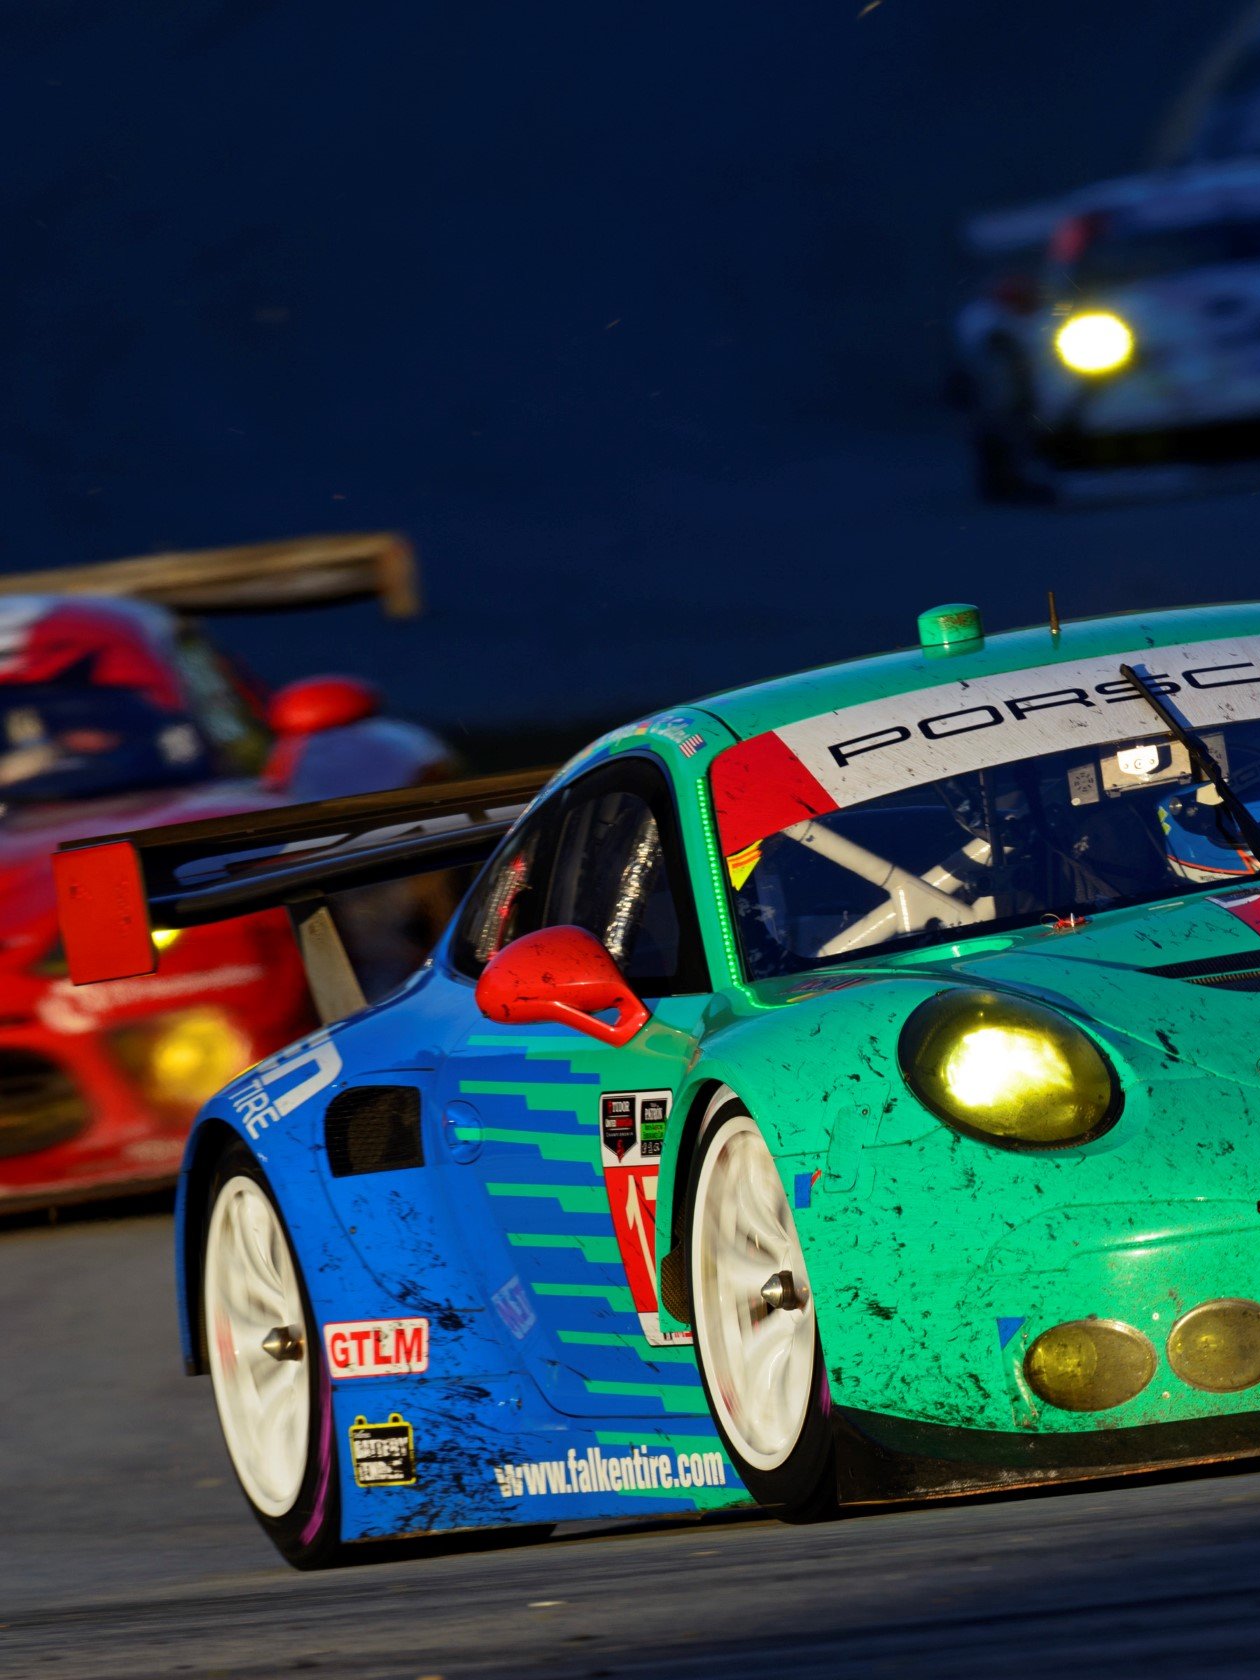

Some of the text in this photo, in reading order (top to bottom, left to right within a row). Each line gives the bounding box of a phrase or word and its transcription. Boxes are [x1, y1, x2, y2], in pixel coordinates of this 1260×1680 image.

[228, 1077, 281, 1140] TIRE
[331, 1327, 423, 1369] GTLM
[493, 1444, 726, 1498] www.falkentire.com
